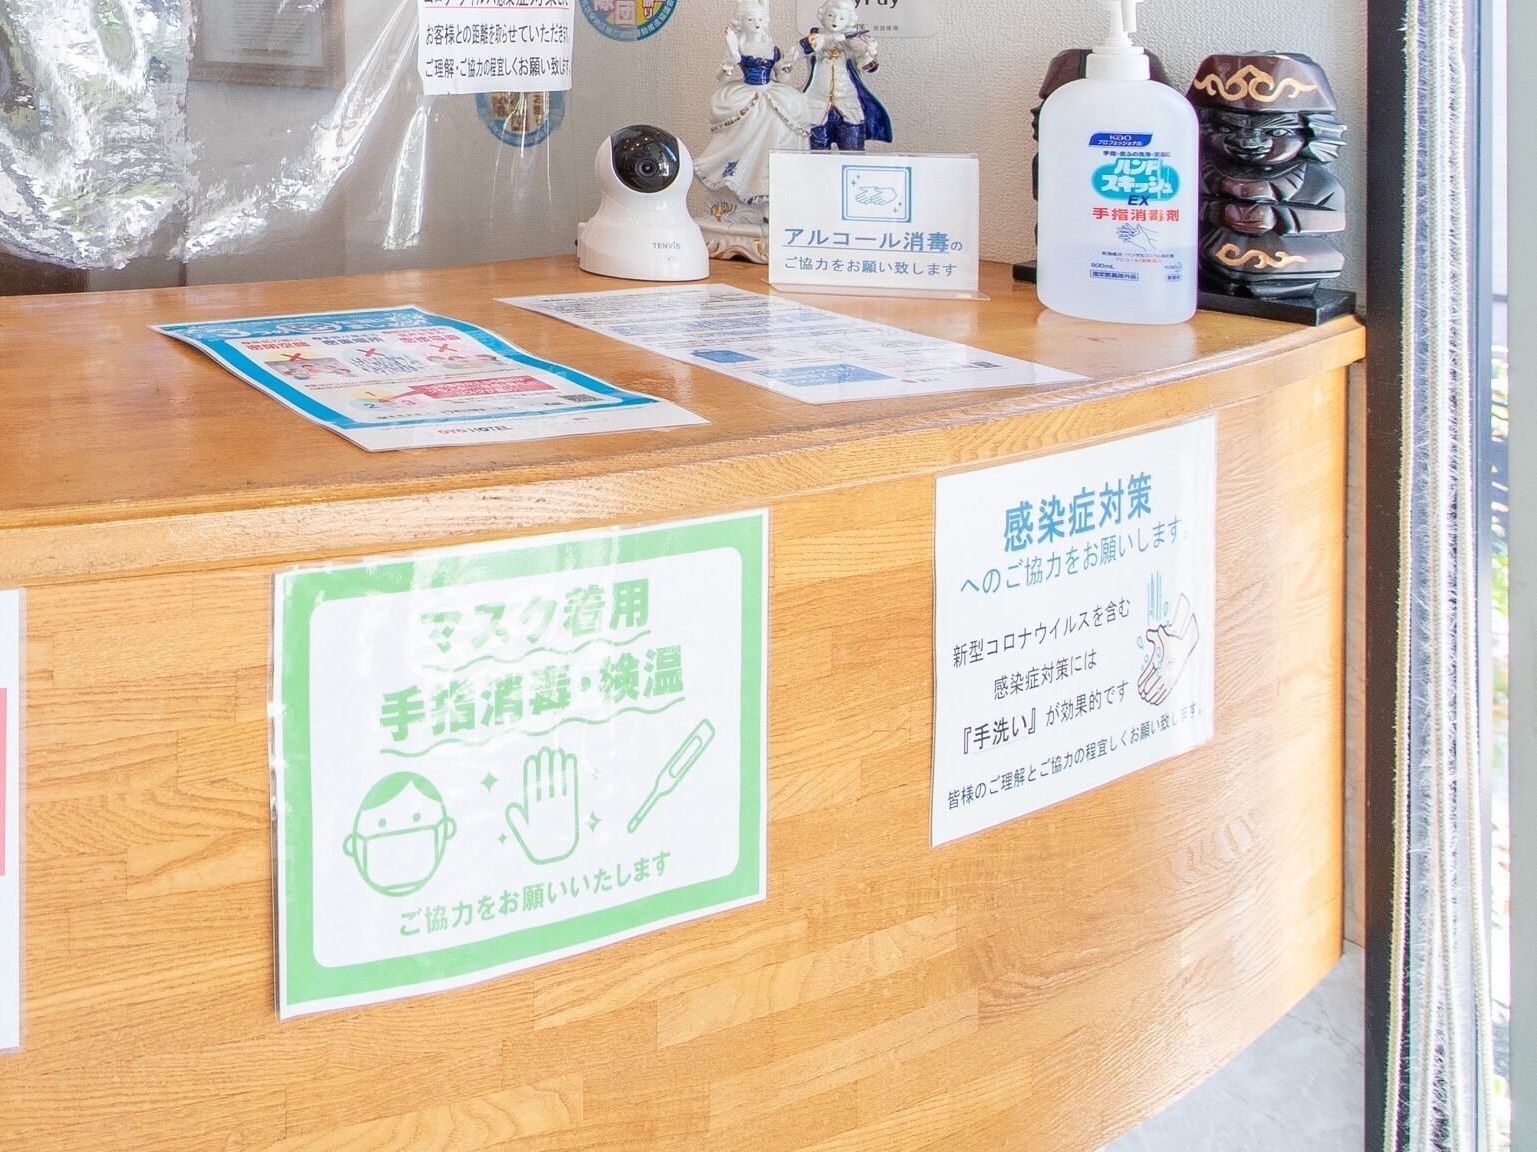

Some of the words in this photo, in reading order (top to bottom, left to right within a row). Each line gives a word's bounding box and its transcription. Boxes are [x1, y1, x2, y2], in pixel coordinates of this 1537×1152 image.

[1092, 207, 1180, 223] 手指消毒剤
[1127, 194, 1150, 206] EX
[784, 228, 963, 253] アルコール消毒の
[784, 256, 957, 277] ご協力をお願い致します
[1004, 472, 1153, 553] 感染症対策
[420, 577, 650, 654] マスク着用
[952, 596, 1132, 669] 新型コロナウイルスを含む
[378, 644, 685, 743] 手指消毒・検温
[993, 648, 1099, 701] 感染症対策には
[399, 850, 672, 937] ご協力をお願いいたします
